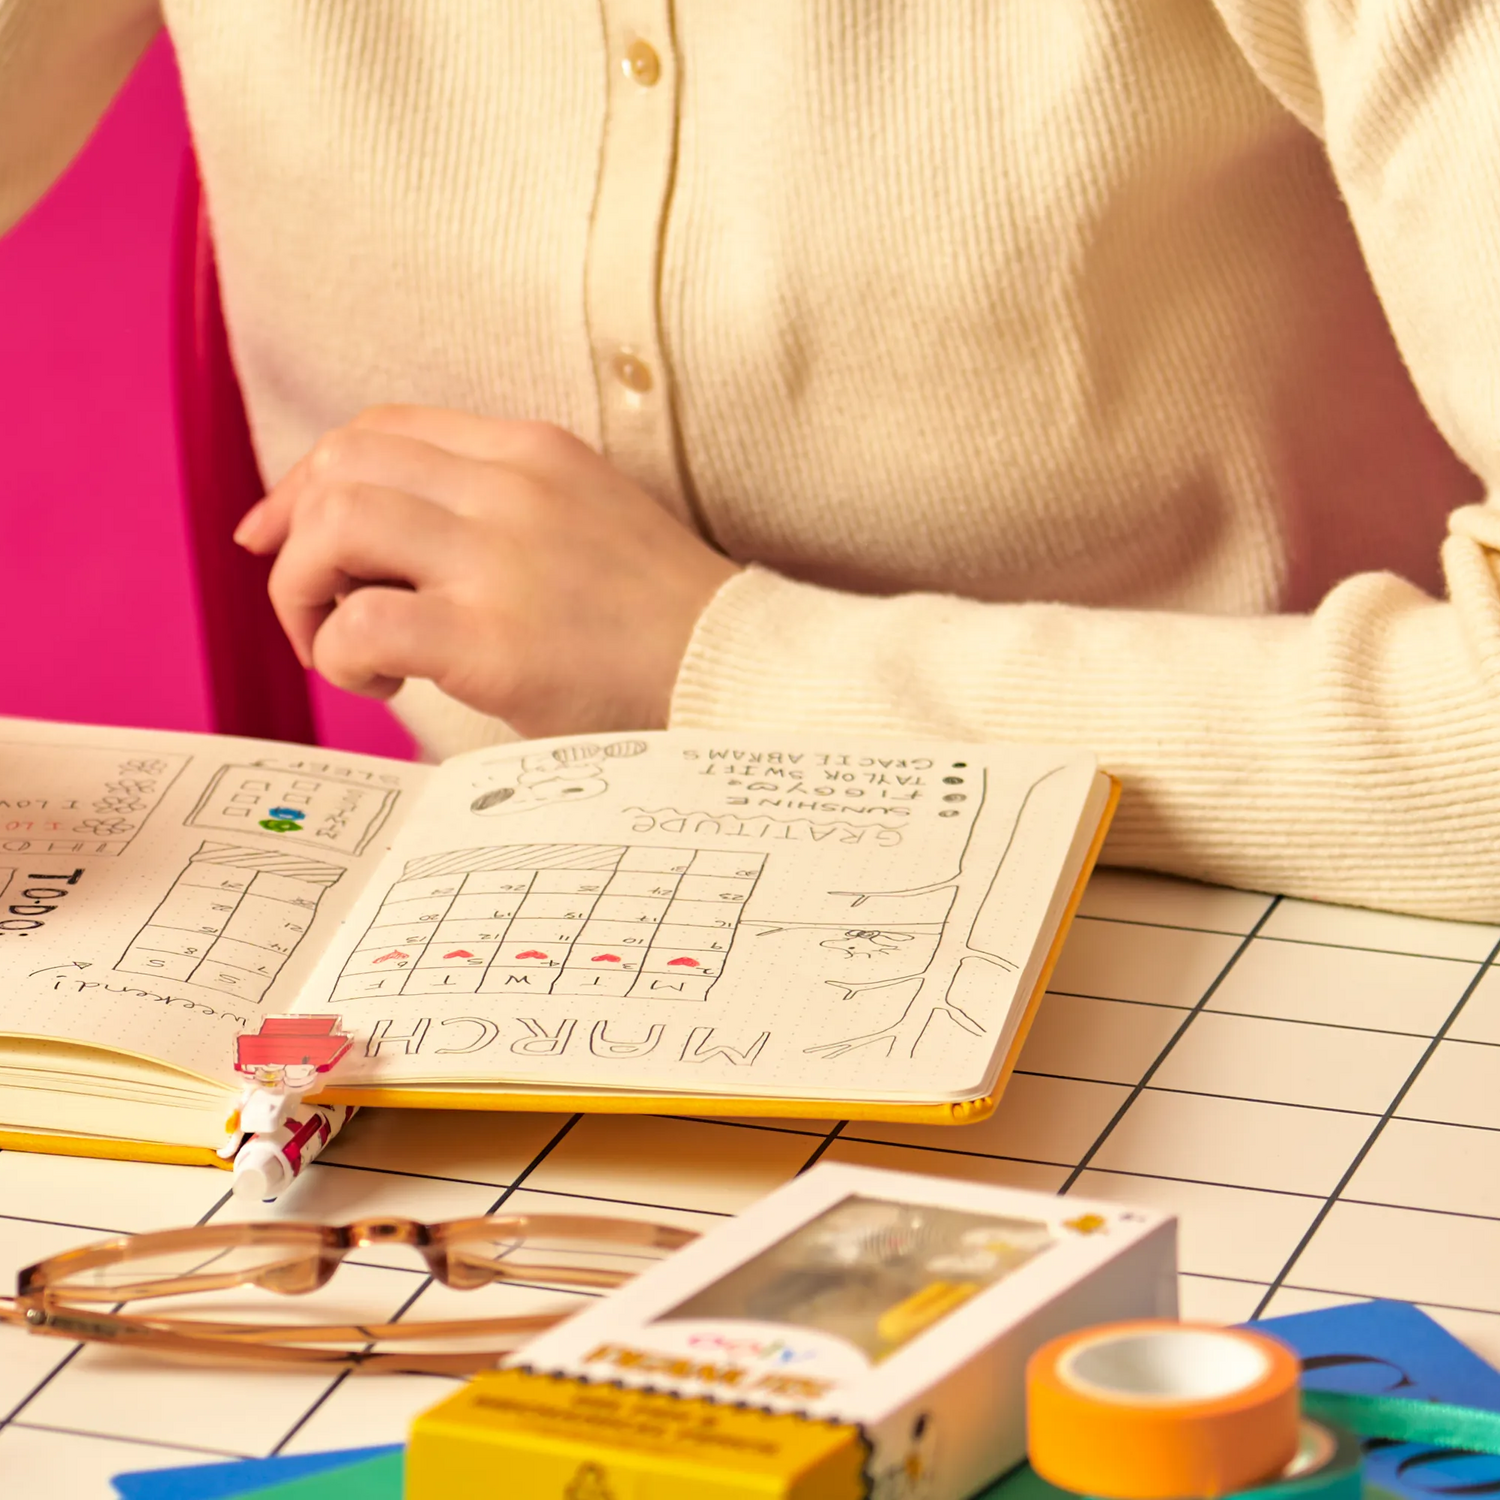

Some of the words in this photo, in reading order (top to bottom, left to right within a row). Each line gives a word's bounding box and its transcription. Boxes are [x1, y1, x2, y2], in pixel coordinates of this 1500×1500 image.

[682, 748, 804, 766] ABRAMS
[814, 753, 933, 771] GRACIE
[698, 764, 804, 780] SWIFT
[823, 769, 926, 787] TAYLOR
[786, 782, 923, 801] FIGGY
[61, 799, 79, 810] I
[725, 795, 911, 817] SUNSHINE
[44, 821, 64, 832] I
[499, 884, 526, 892] 26
[647, 887, 673, 896] 24
[718, 892, 744, 901] 23
[419, 913, 440, 922] 20
[492, 910, 511, 919] 19
[635, 914, 657, 923] 17
[283, 922, 304, 933] 21
[714, 920, 732, 928] 16
[197, 926, 219, 934] 15
[405, 935, 427, 944] 13
[477, 933, 499, 941] 12
[558, 934, 570, 942] 11
[622, 937, 644, 945] 10
[267, 943, 289, 953] 14
[710, 941, 723, 950] 9
[183, 947, 198, 955] 8
[145, 959, 166, 968] S
[397, 960, 409, 968] 6
[467, 957, 483, 965] 5
[540, 959, 560, 968] 4
[257, 966, 269, 975] 7
[621, 962, 638, 970] 3
[695, 967, 715, 975] 2
[218, 973, 241, 985] S
[428, 974, 457, 987] T
[504, 974, 531, 986] W
[579, 976, 603, 987] T
[364, 978, 386, 991] F
[649, 979, 684, 992] M
[53, 974, 247, 1027] weekend!
[363, 1017, 772, 1067] MARCH
